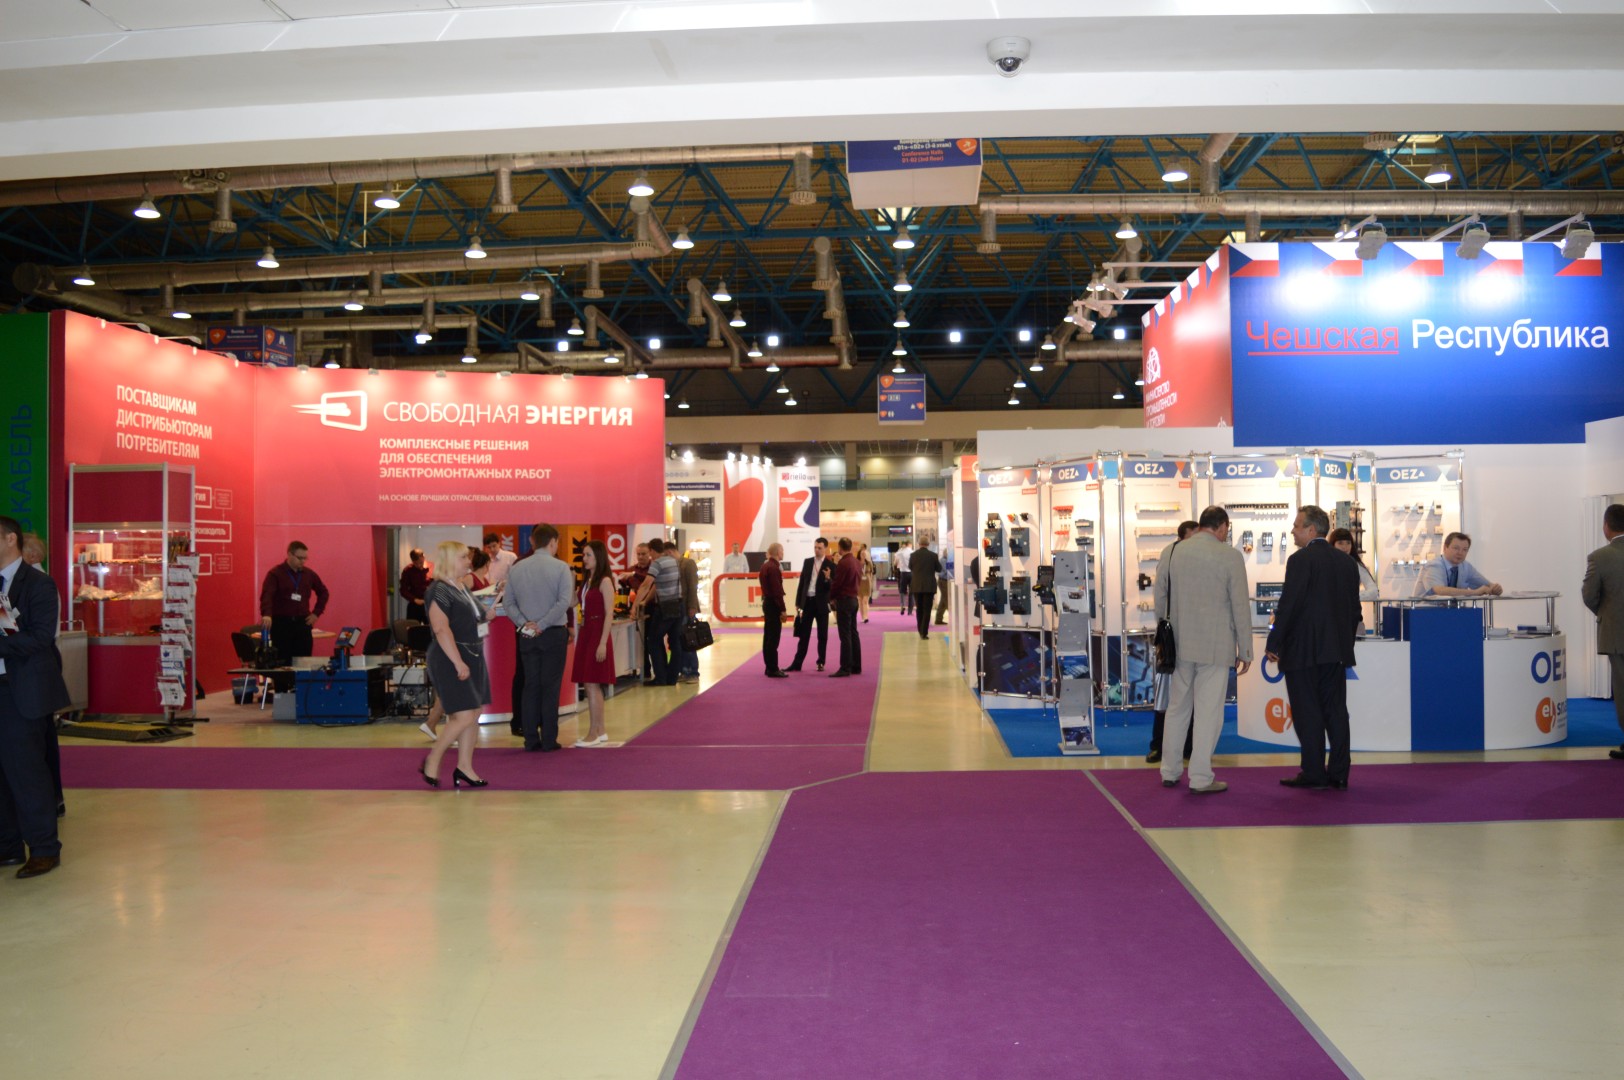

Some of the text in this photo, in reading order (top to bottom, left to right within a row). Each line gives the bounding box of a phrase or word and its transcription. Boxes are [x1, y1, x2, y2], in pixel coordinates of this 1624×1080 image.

[1247, 318, 1610, 355] Чешская Республика
[116, 384, 197, 416] ПОСТАВЩИКАМ
[383, 401, 633, 426] СВОБОДНАЯ ЭНЕРГИЯ
[116, 408, 213, 440] ДИСТРИБЬЮТОРАМ
[116, 432, 200, 459] ПОТРЕБИТЕЛЯМ
[379, 438, 529, 451] КОМПЛЕКСНЫЕ РЕШЕНИЯ
[379, 453, 492, 466] ДЛЯ ОБЕСПЕЧЕНИЯ
[379, 467, 551, 480] ЭЛЕКТРОМОНТАЖНЫХ РАБОТ
[1058, 468, 1076, 480] OEZ
[1134, 463, 1159, 475] OEZ
[1226, 464, 1255, 476] OEZ
[1325, 463, 1339, 475] OEZ
[1390, 469, 1419, 480] OEZ
[988, 474, 1009, 485] OEZ
[379, 493, 552, 503] НА ОСНОВЕ ЛУЧШИХ ОТРАСЛЕВЫХ ВОЗМОЖНОСТЕЙ
